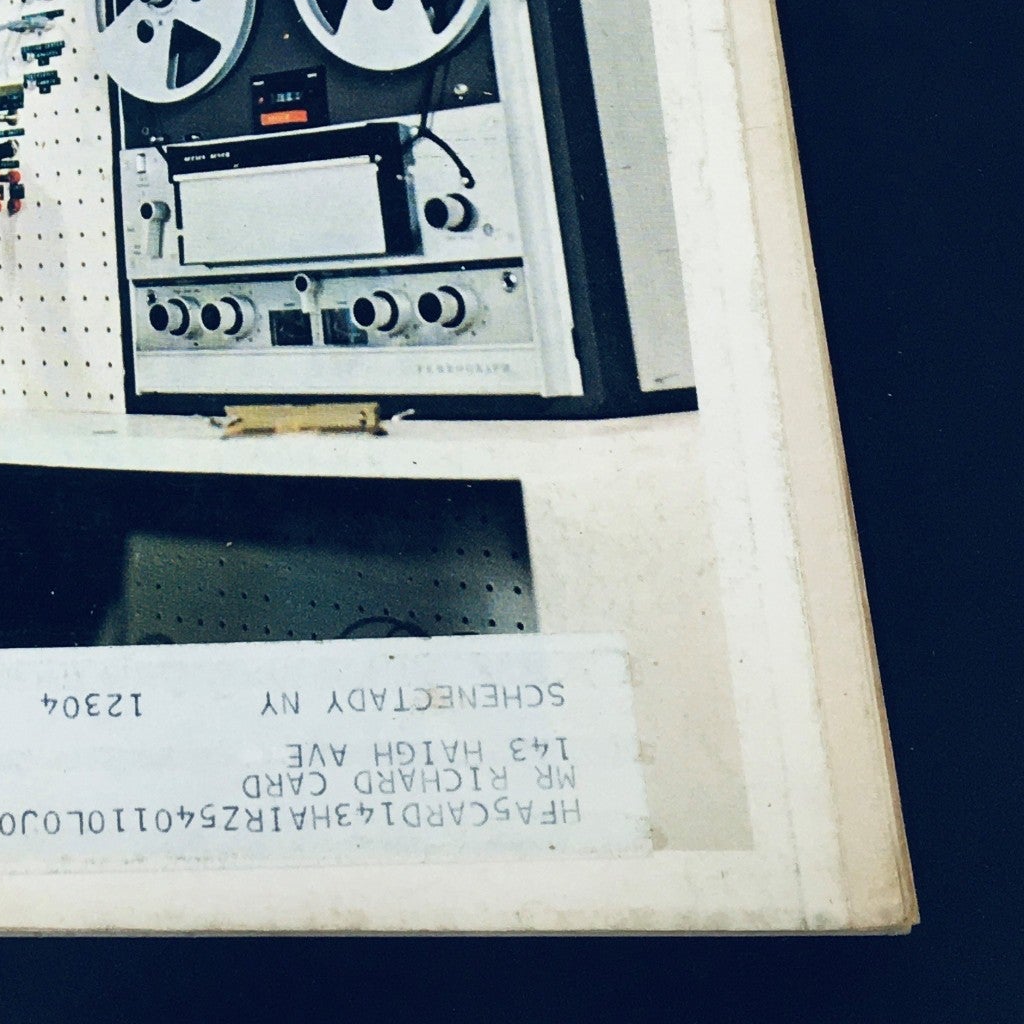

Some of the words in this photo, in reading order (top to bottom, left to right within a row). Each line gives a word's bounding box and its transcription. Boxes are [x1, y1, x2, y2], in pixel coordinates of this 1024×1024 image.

[41, 693, 142, 719] 12304
[261, 691, 299, 715] NY
[327, 682, 564, 713] SCHENECTADY
[287, 743, 346, 768] AVE
[374, 740, 482, 766] HAIGH
[510, 737, 568, 762] 143
[242, 771, 326, 798] CARD
[354, 763, 506, 794] RICHARD
[535, 765, 575, 789] MR
